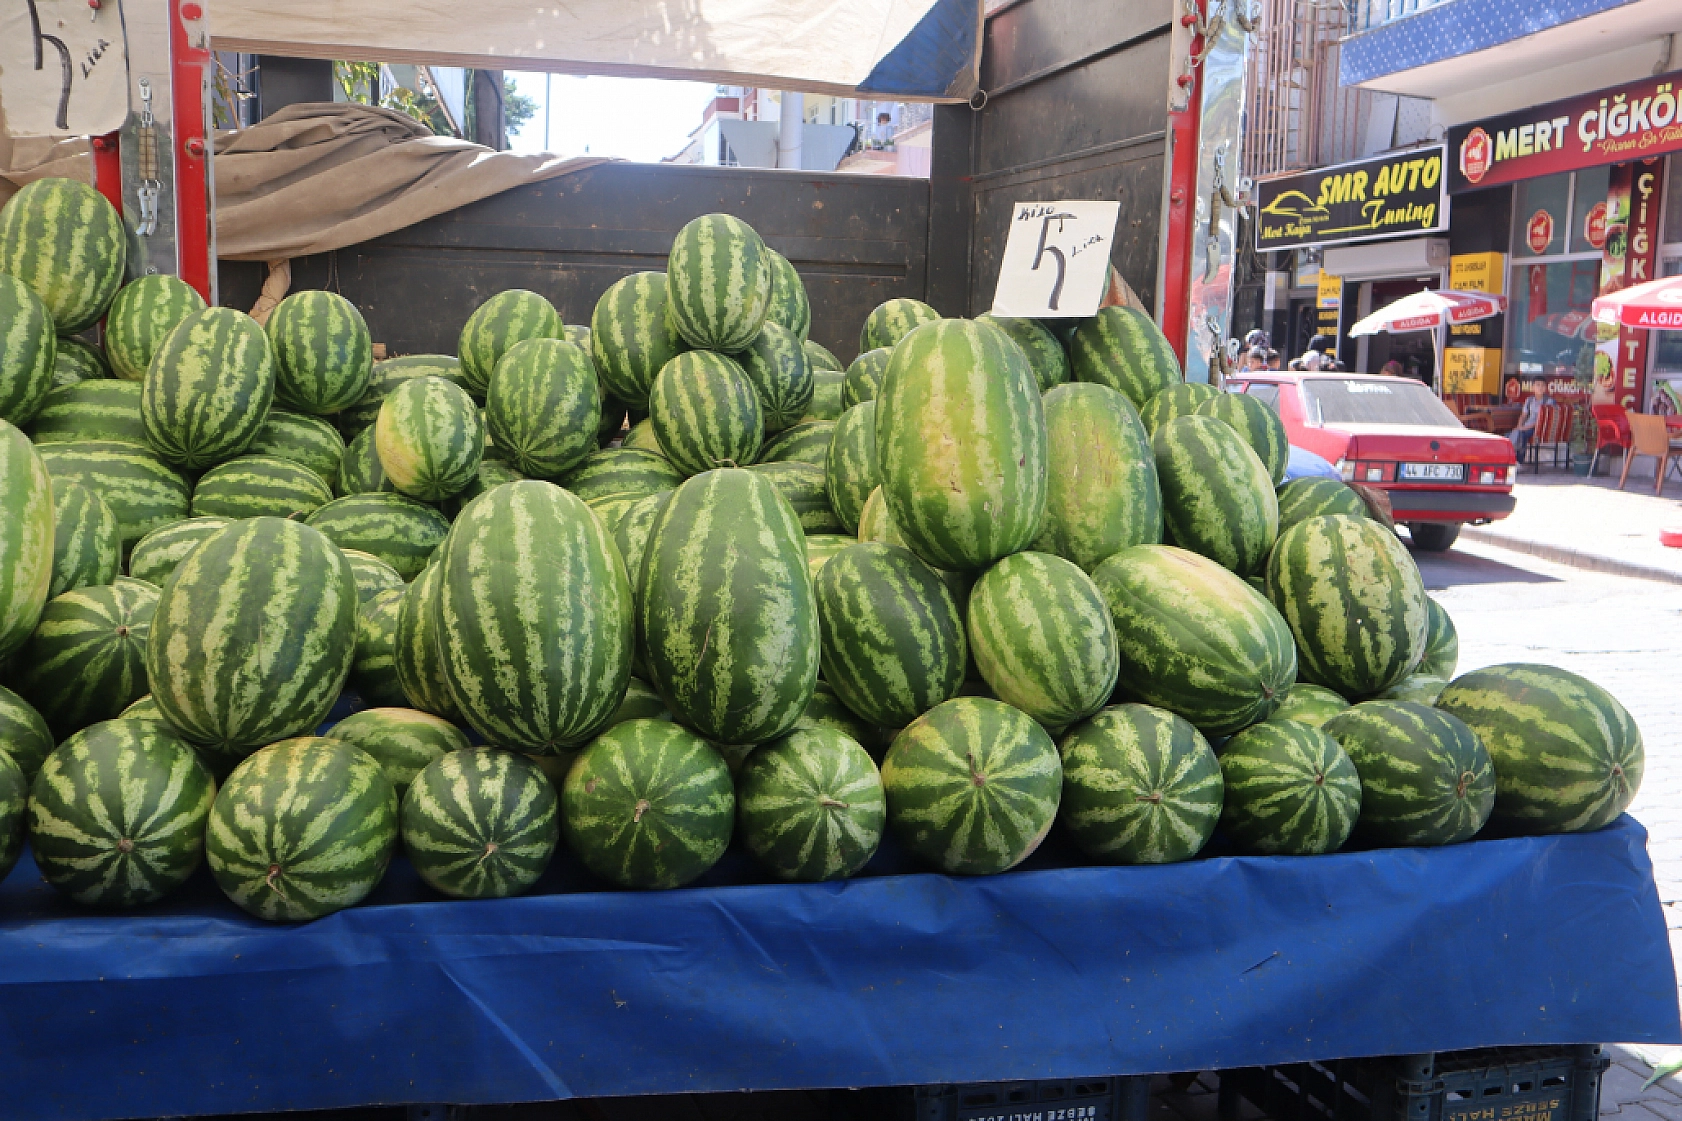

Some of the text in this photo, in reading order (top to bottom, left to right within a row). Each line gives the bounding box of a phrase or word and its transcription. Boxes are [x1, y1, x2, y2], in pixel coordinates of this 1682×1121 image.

[1495, 82, 1682, 162] MERT ÇİĞKÖ
[1317, 156, 1441, 207] SMR AUTO
[1361, 199, 1436, 230] Tuning
[1031, 213, 1078, 311] 5
[1405, 464, 1418, 477] 44
